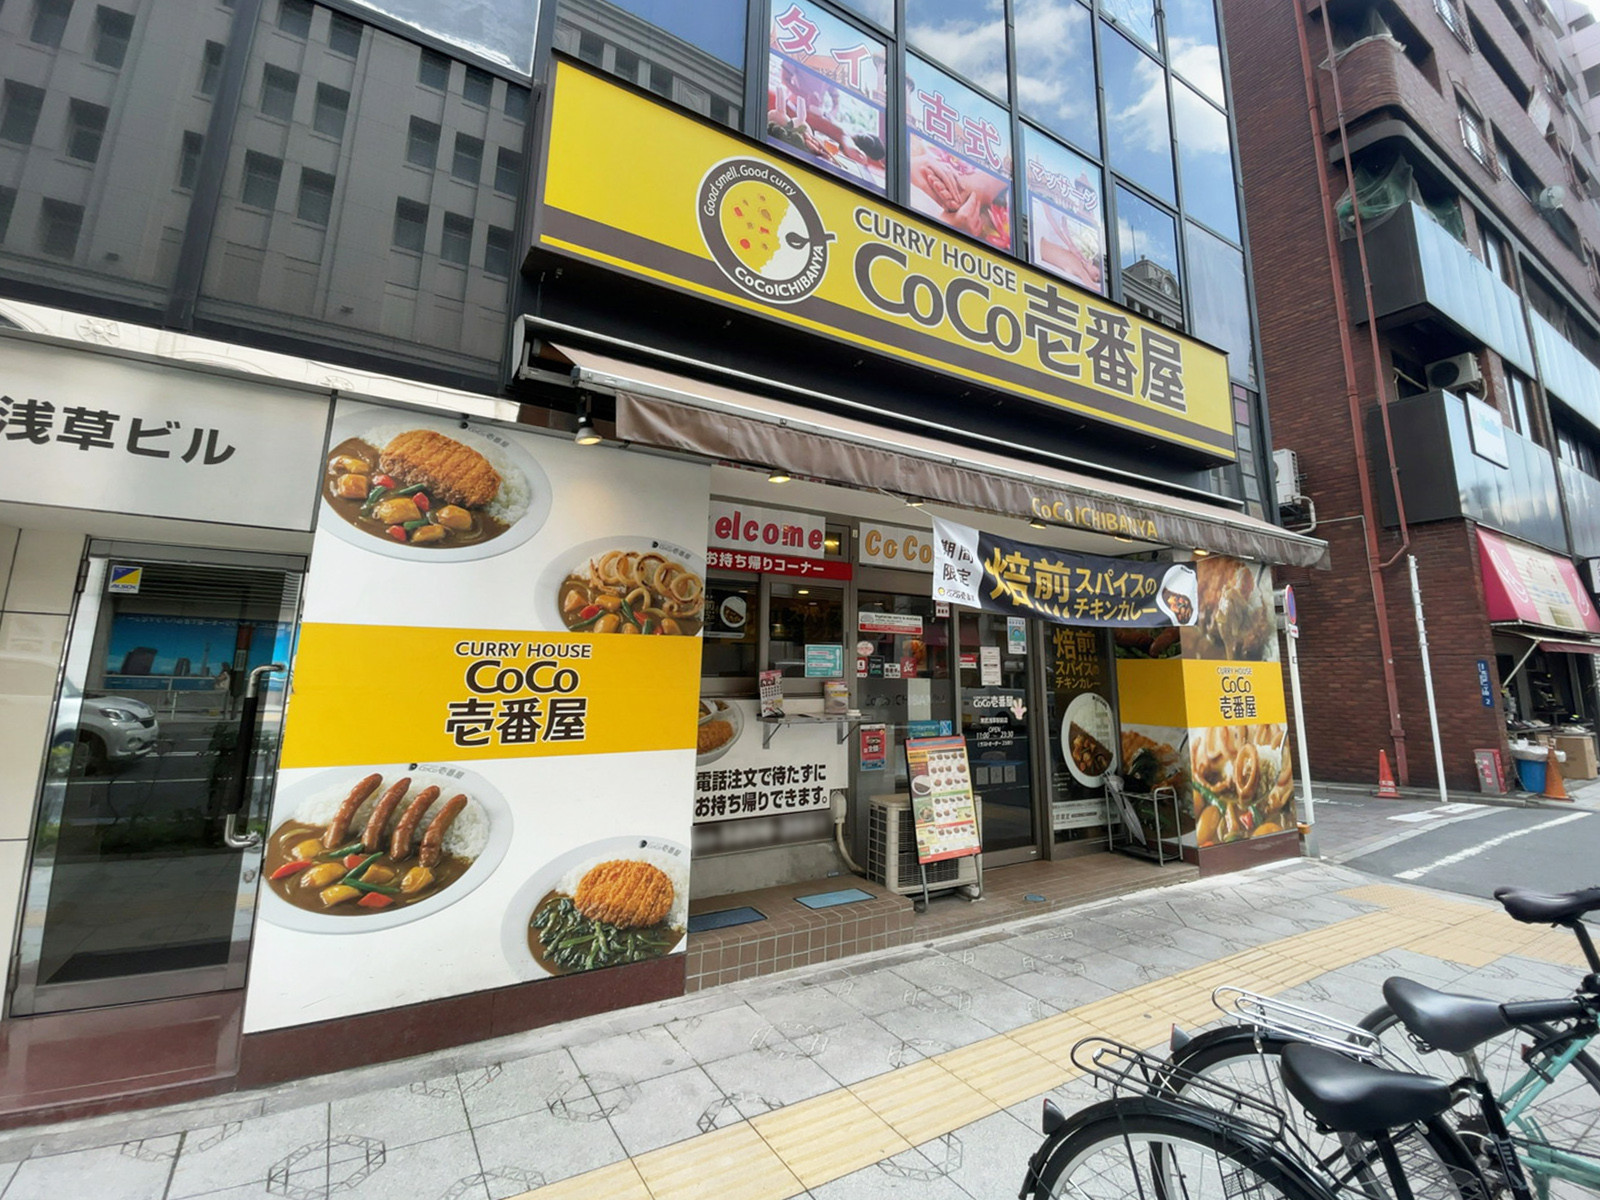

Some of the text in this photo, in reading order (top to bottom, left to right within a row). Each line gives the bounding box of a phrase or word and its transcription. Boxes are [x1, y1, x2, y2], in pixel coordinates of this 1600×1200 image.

[775, 4, 870, 90] タイ
[918, 89, 1001, 170] 古式
[704, 184, 719, 217] Good
[769, 174, 797, 196] curry
[1028, 160, 1099, 211] マッサージ
[854, 208, 1018, 292] CURRY HOUSE
[734, 245, 824, 297] CoCoICHIBANYA
[854, 243, 1187, 413] CoCo壱番屋
[0, 395, 236, 465] 浅草ビル
[706, 551, 825, 573] お持ち帰りコーナー
[941, 539, 974, 564] 期間
[942, 563, 971, 587] 限定
[984, 547, 1071, 619] 焙煎
[1075, 568, 1157, 598] スパイスの
[1073, 597, 1158, 621] チキンカレー
[456, 641, 591, 658] CURRY HOUSE
[1053, 628, 1098, 662] 焙煎
[466, 660, 579, 694] CoCo
[1056, 676, 1100, 689] チキンカレー
[1222, 676, 1251, 693] CoCo
[446, 697, 587, 747] 壱番屋
[1219, 695, 1257, 719] 壱番屋
[696, 764, 826, 793] 電話注文で待たずに
[695, 786, 828, 817] お持ち帰りできます。
